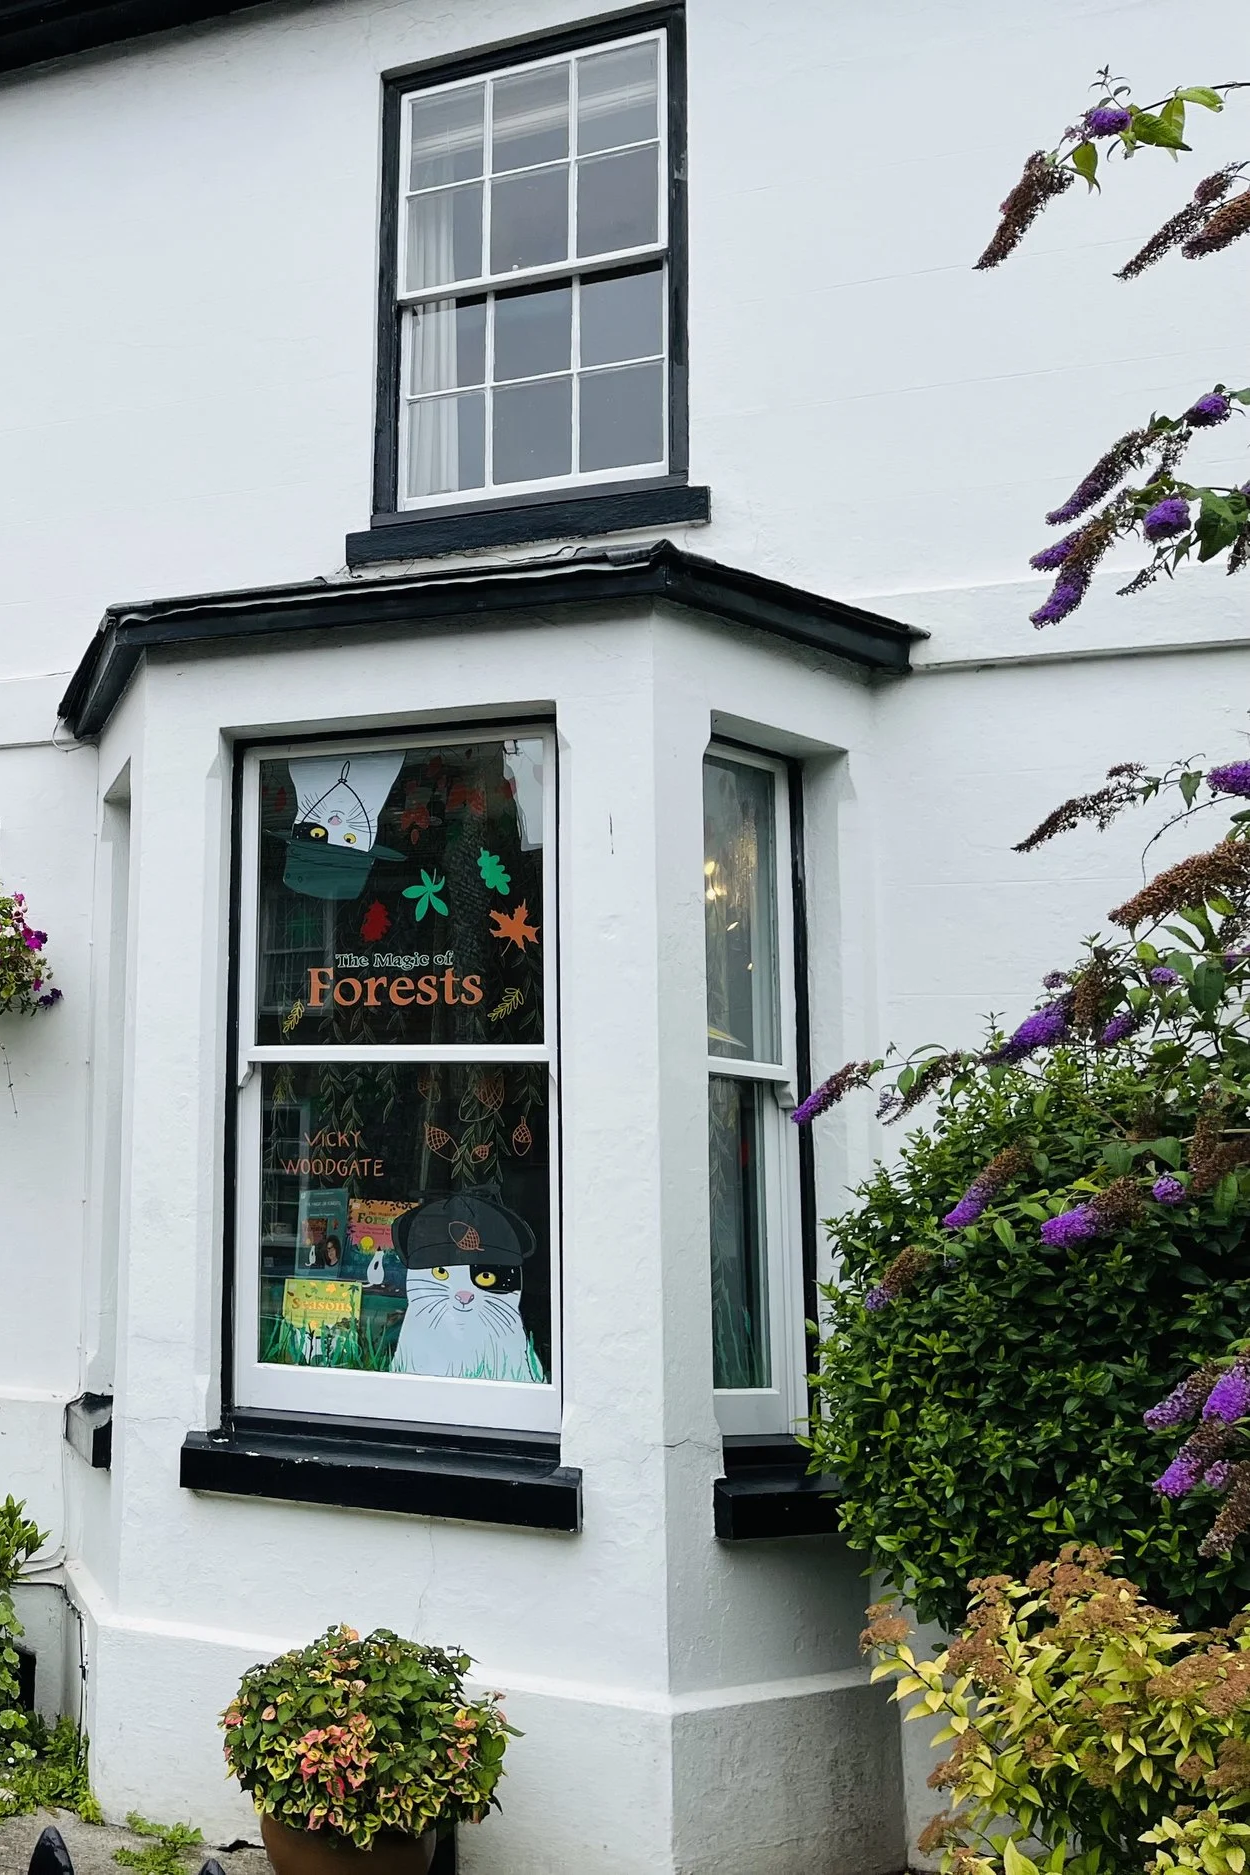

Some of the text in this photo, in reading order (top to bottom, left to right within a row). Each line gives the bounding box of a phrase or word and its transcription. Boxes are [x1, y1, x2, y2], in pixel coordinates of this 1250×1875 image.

[335, 950, 454, 971] The Magic of
[306, 967, 484, 1007] Forests
[304, 1130, 361, 1148] VICKY
[281, 1157, 385, 1177] WOODGATE
[292, 1297, 353, 1312] Seasons
